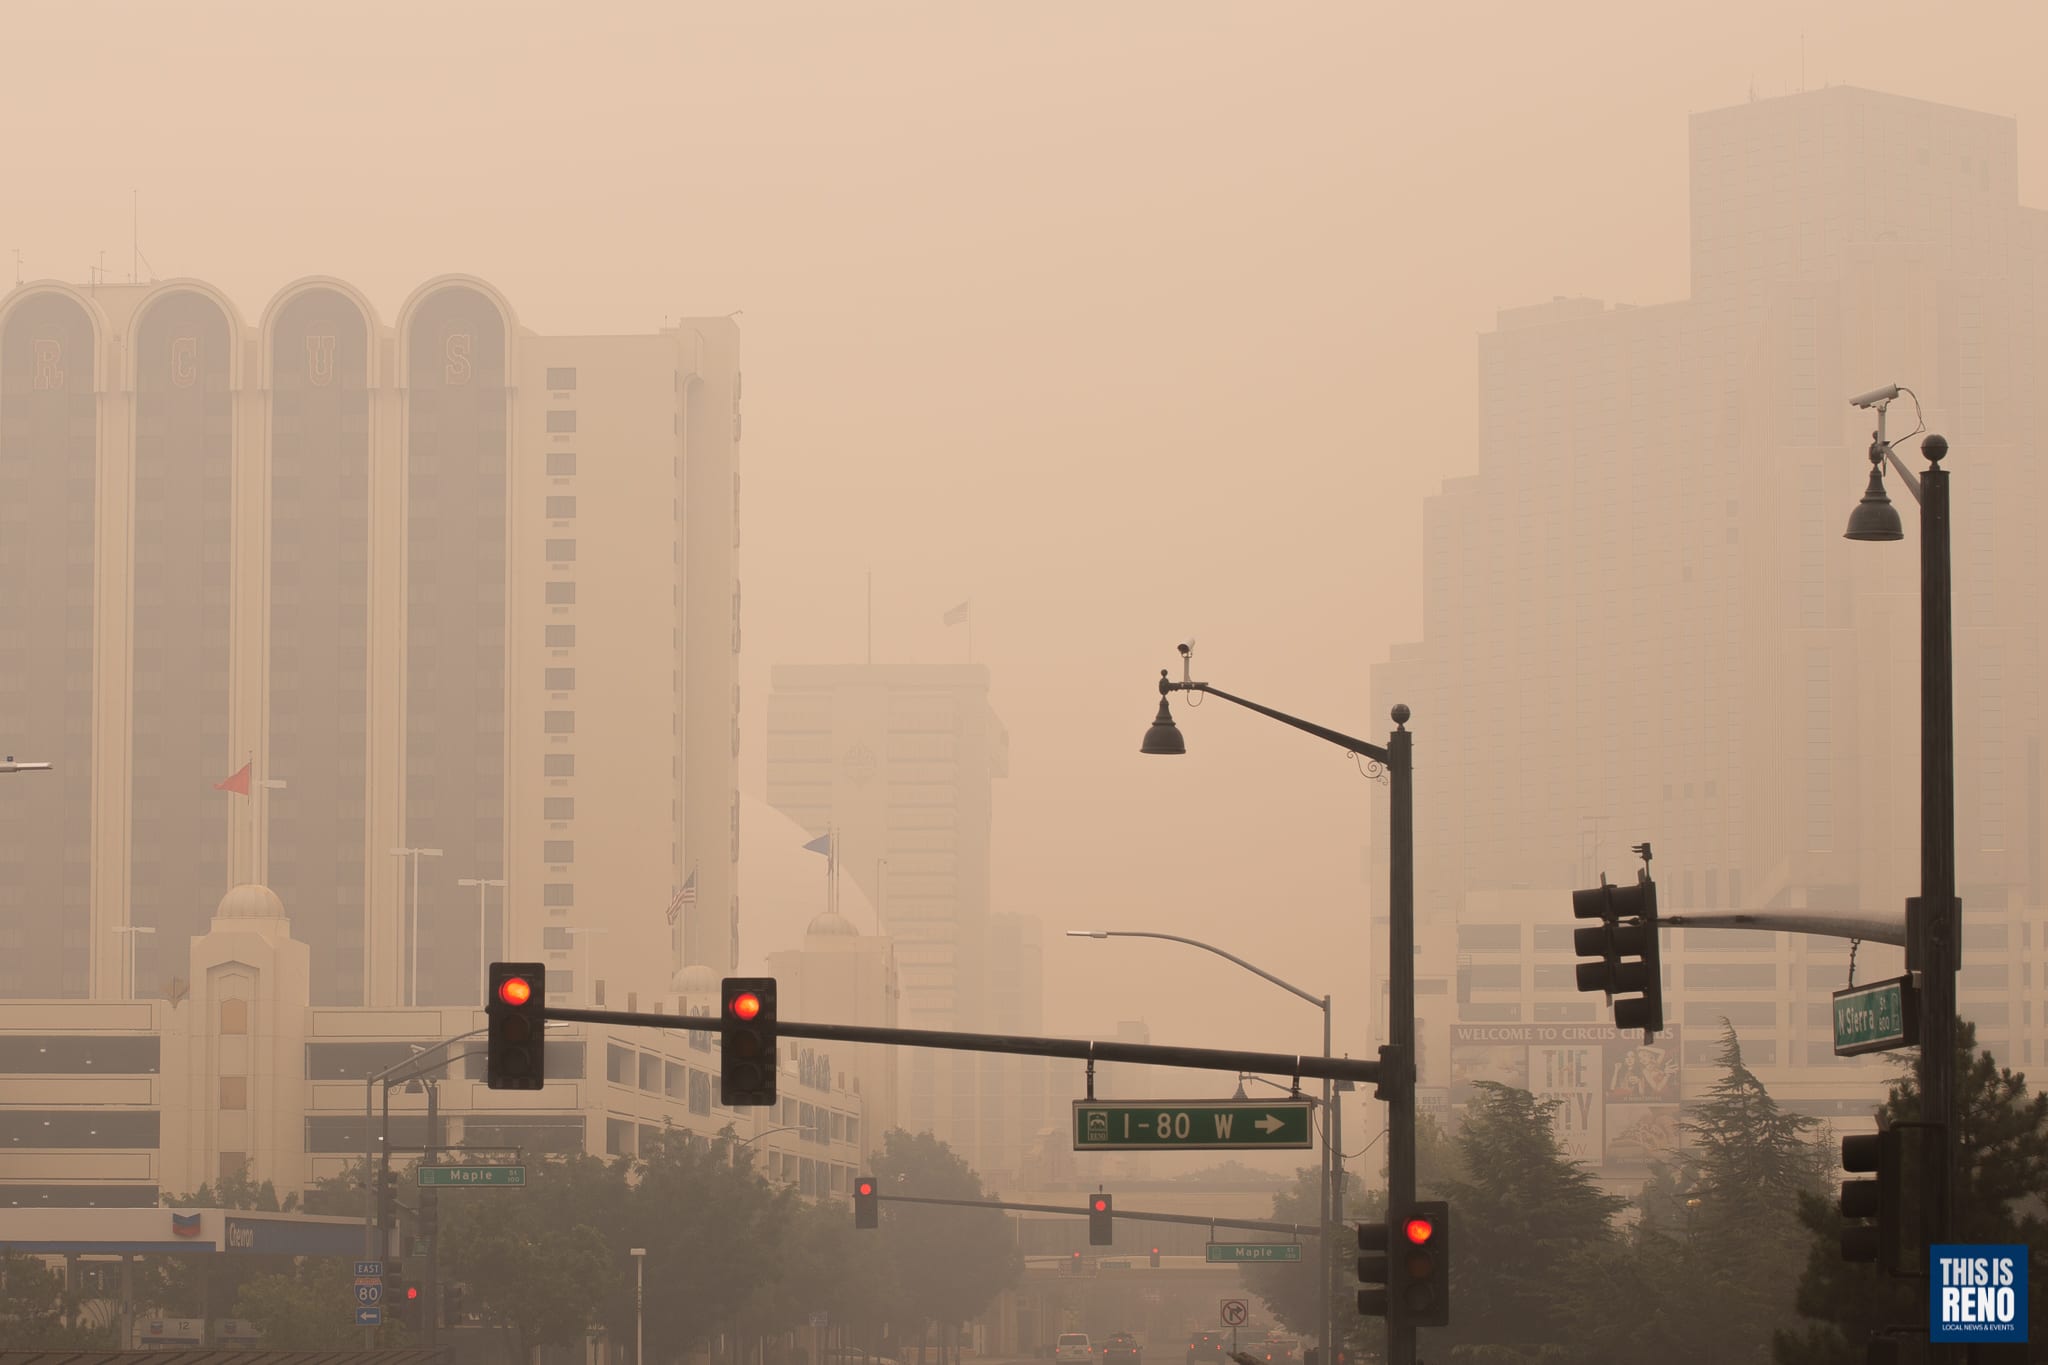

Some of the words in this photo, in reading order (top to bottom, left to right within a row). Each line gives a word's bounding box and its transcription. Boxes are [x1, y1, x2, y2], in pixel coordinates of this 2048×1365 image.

[1838, 1008, 1845, 1036] N
[1846, 1007, 1875, 1035] Sierra
[1457, 1028, 1533, 1041] WELCOME
[1537, 1027, 1557, 1040] TO
[1562, 1027, 1616, 1040] CIRCUS
[1620, 1027, 1674, 1040] CIRUS
[1542, 1049, 1588, 1088] THE
[1539, 1092, 1593, 1130] ITY
[1214, 1113, 1233, 1139] W
[450, 1169, 493, 1182] Maple
[229, 1222, 254, 1249] Chevron
[1235, 1247, 1273, 1258] Maple
[357, 1264, 380, 1274] EAST
[359, 1287, 378, 1301] 80
[178, 1321, 190, 1330] 12
